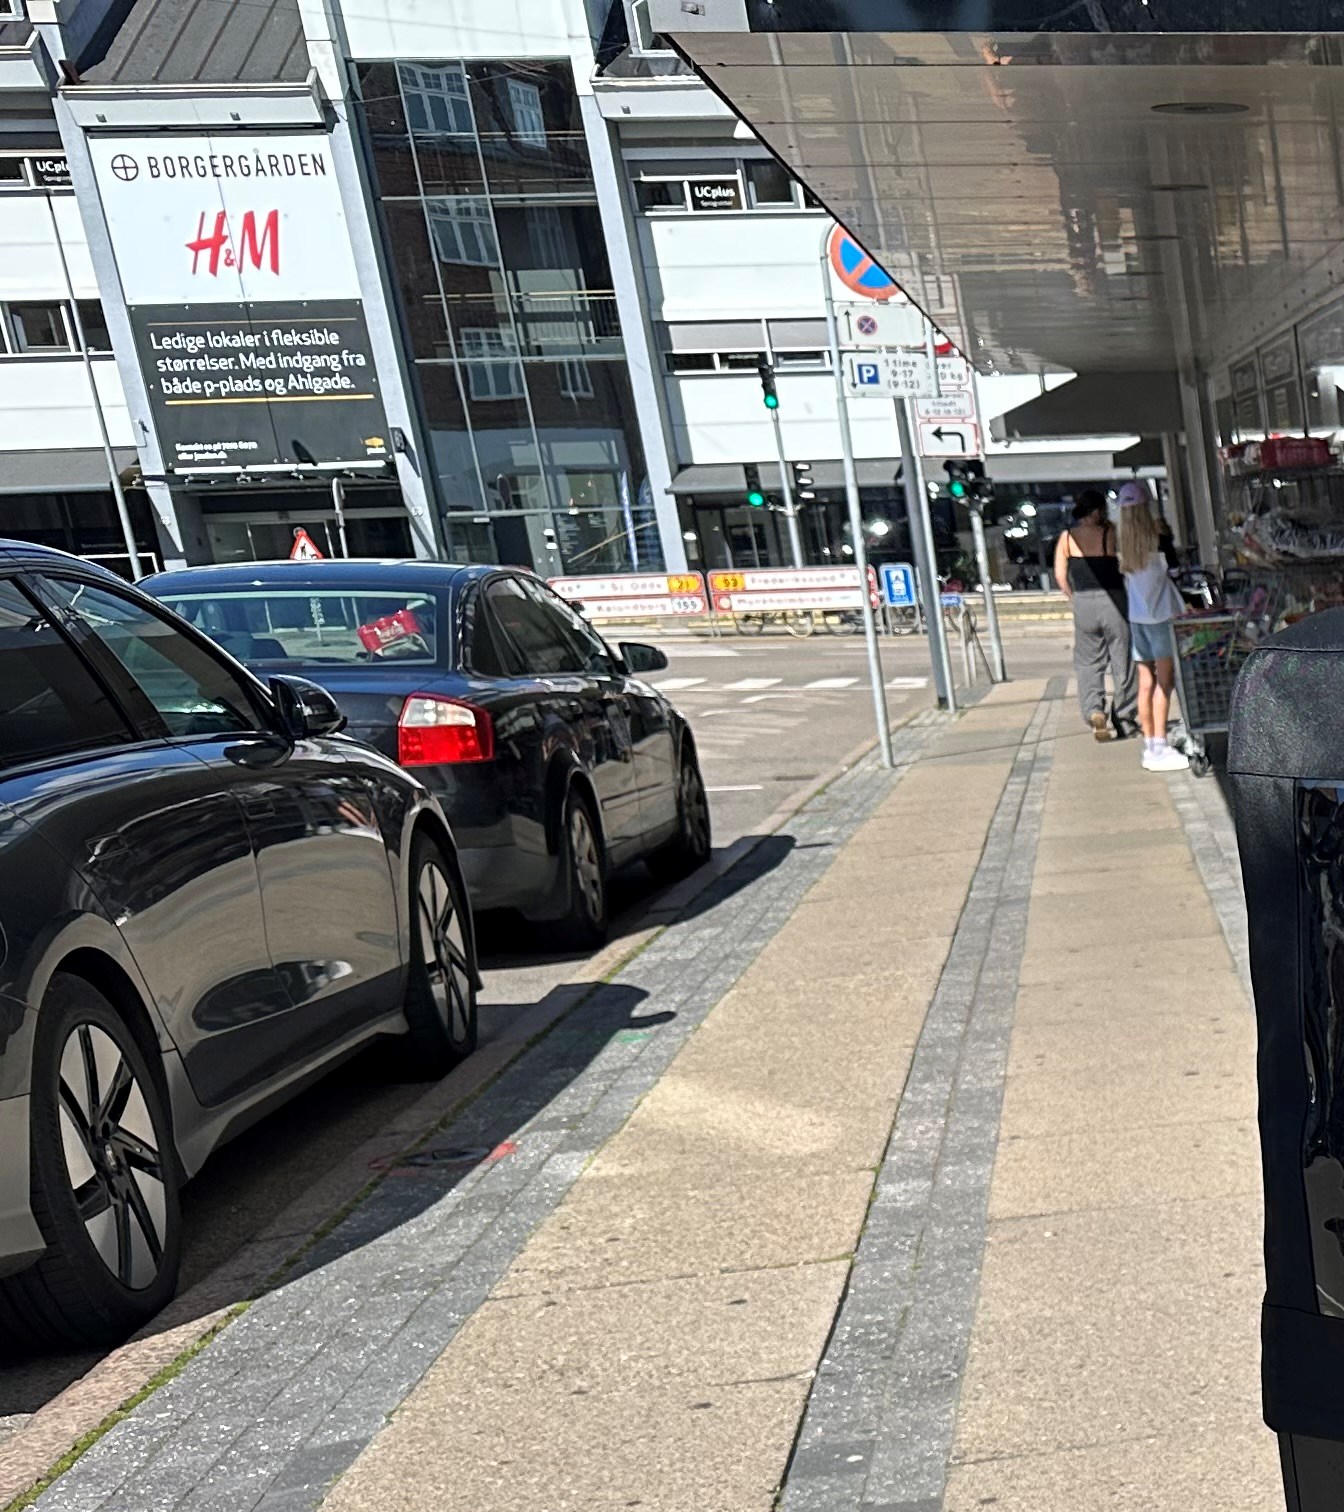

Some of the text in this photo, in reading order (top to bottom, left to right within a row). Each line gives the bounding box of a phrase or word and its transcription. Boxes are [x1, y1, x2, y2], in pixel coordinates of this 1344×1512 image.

[36, 160, 71, 173] UCpl
[147, 148, 327, 178] BORGERGÅRDEN
[694, 185, 736, 199] UCplus
[185, 209, 280, 277] H&M
[150, 327, 340, 353] Ledige lokaler i fleksible
[156, 350, 367, 373] størrelser. Med indgang fra
[160, 373, 356, 396] både p-plads og Ahlgade.
